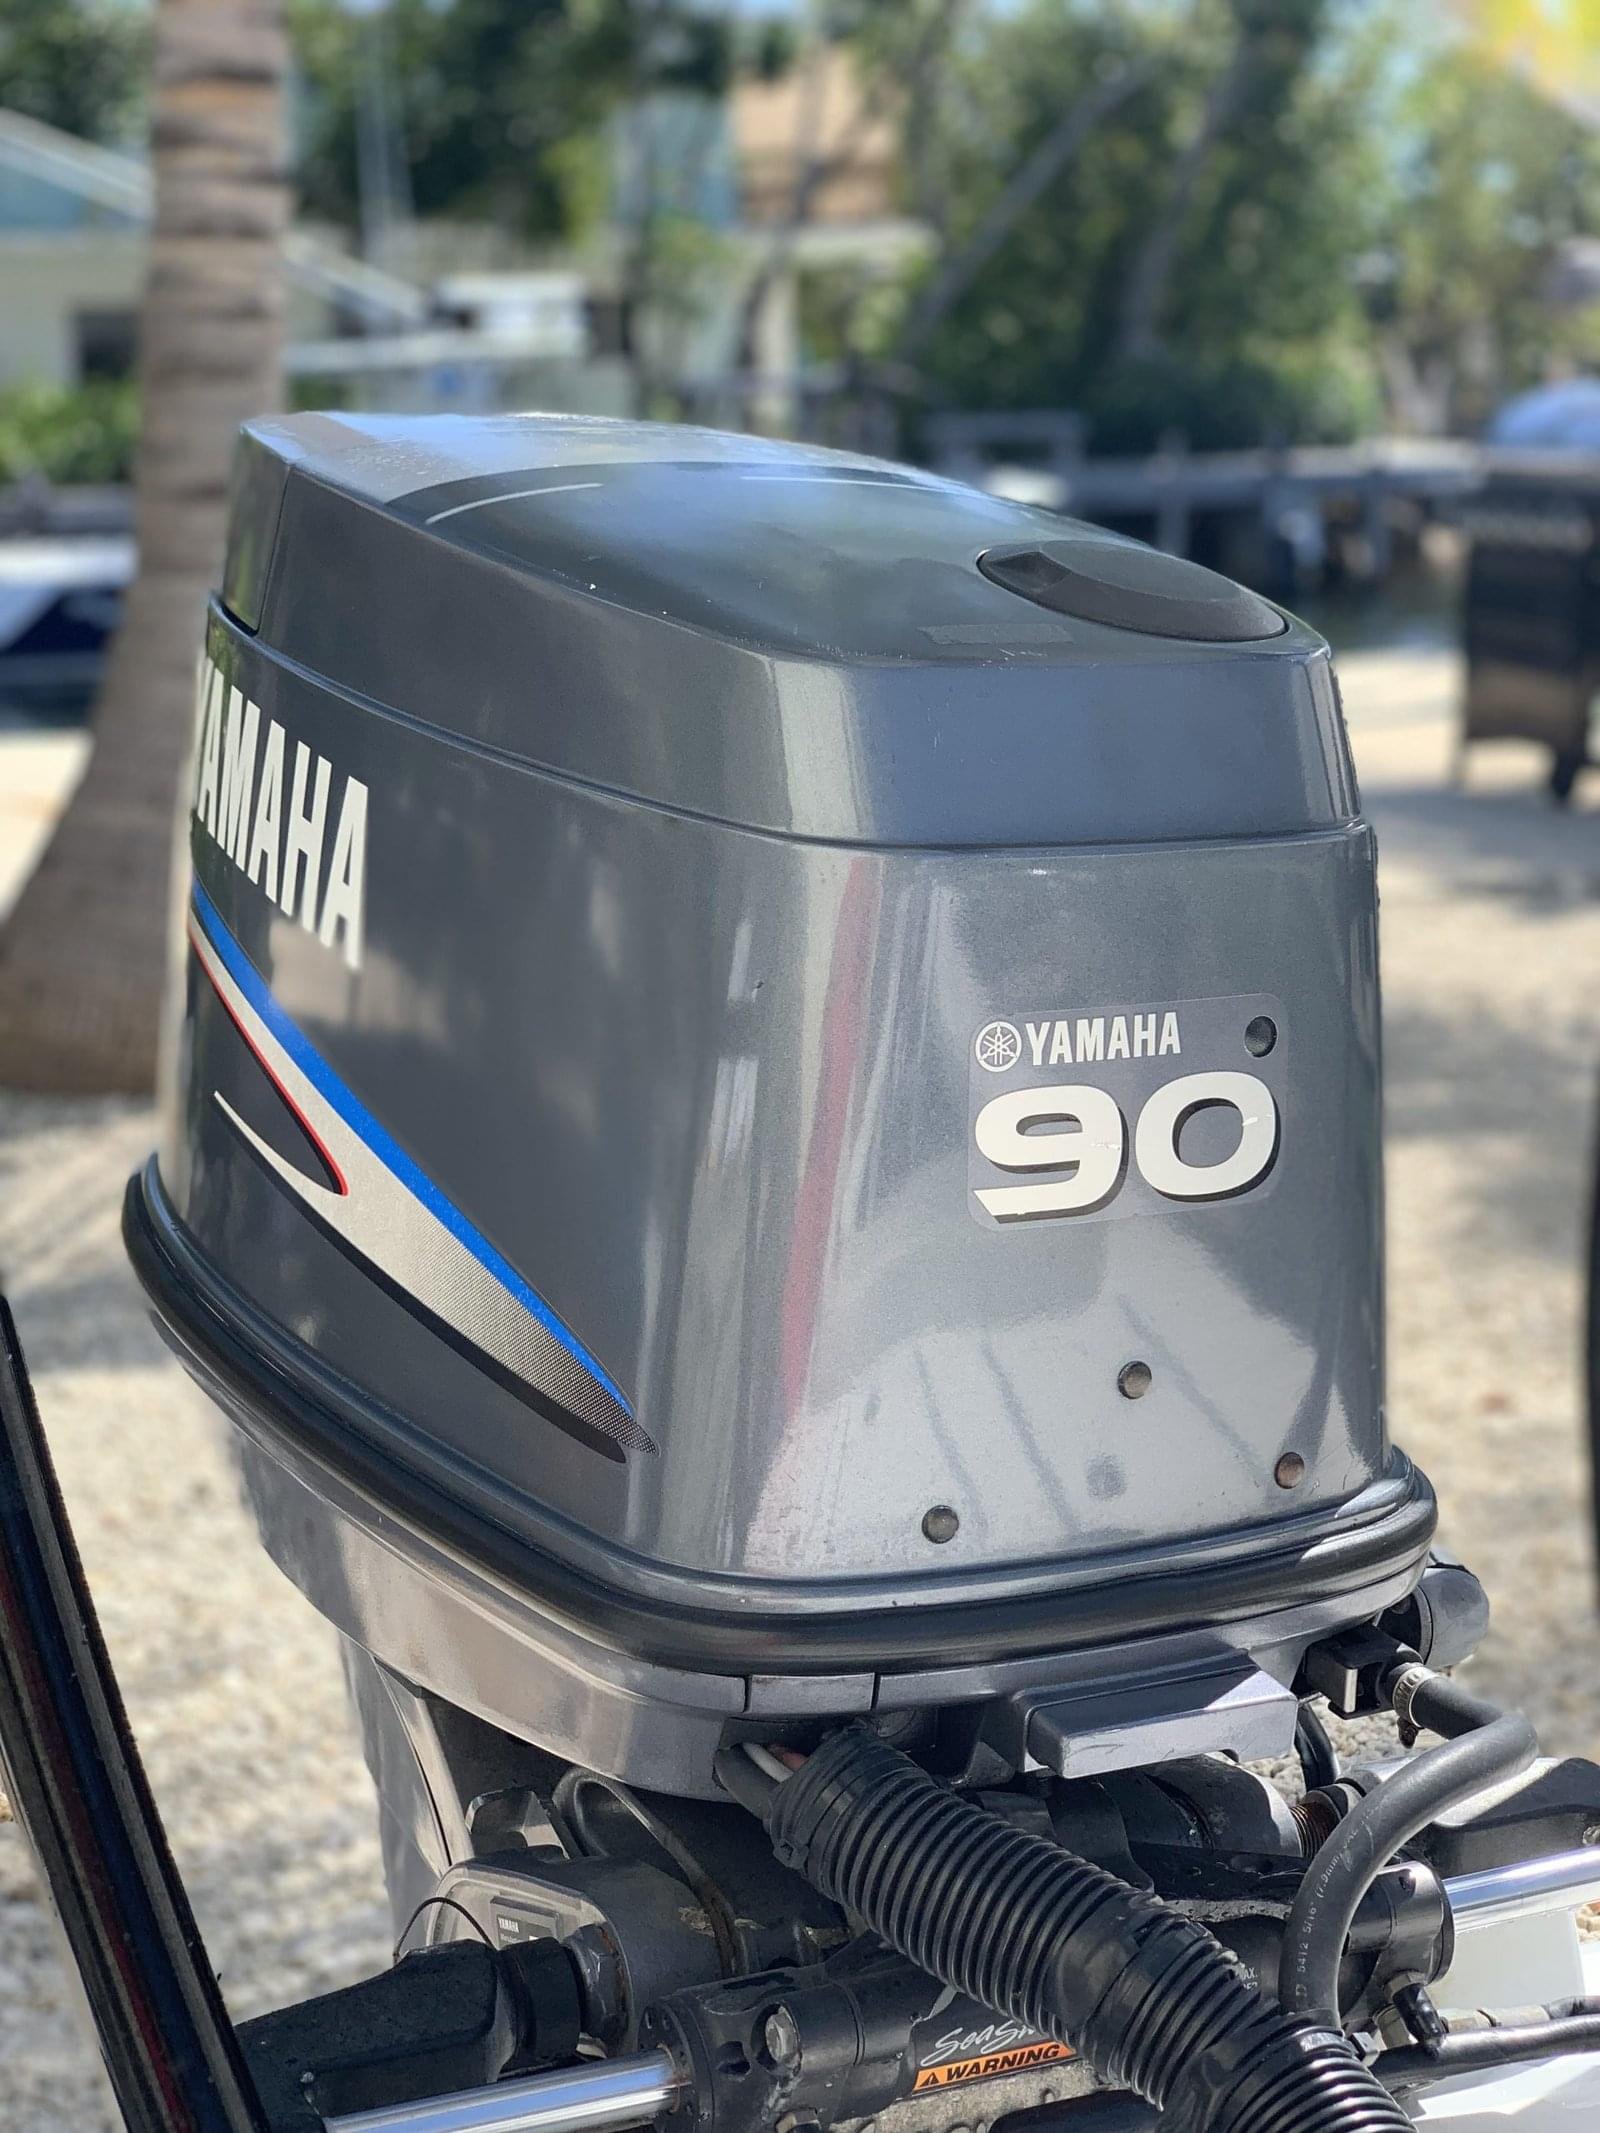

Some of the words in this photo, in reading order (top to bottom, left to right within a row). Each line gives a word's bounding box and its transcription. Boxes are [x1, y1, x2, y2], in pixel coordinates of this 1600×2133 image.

[1025, 1011, 1181, 1066] YAMAHA
[973, 1071, 1280, 1223] 90
[946, 2044, 1060, 2081] WARNING
